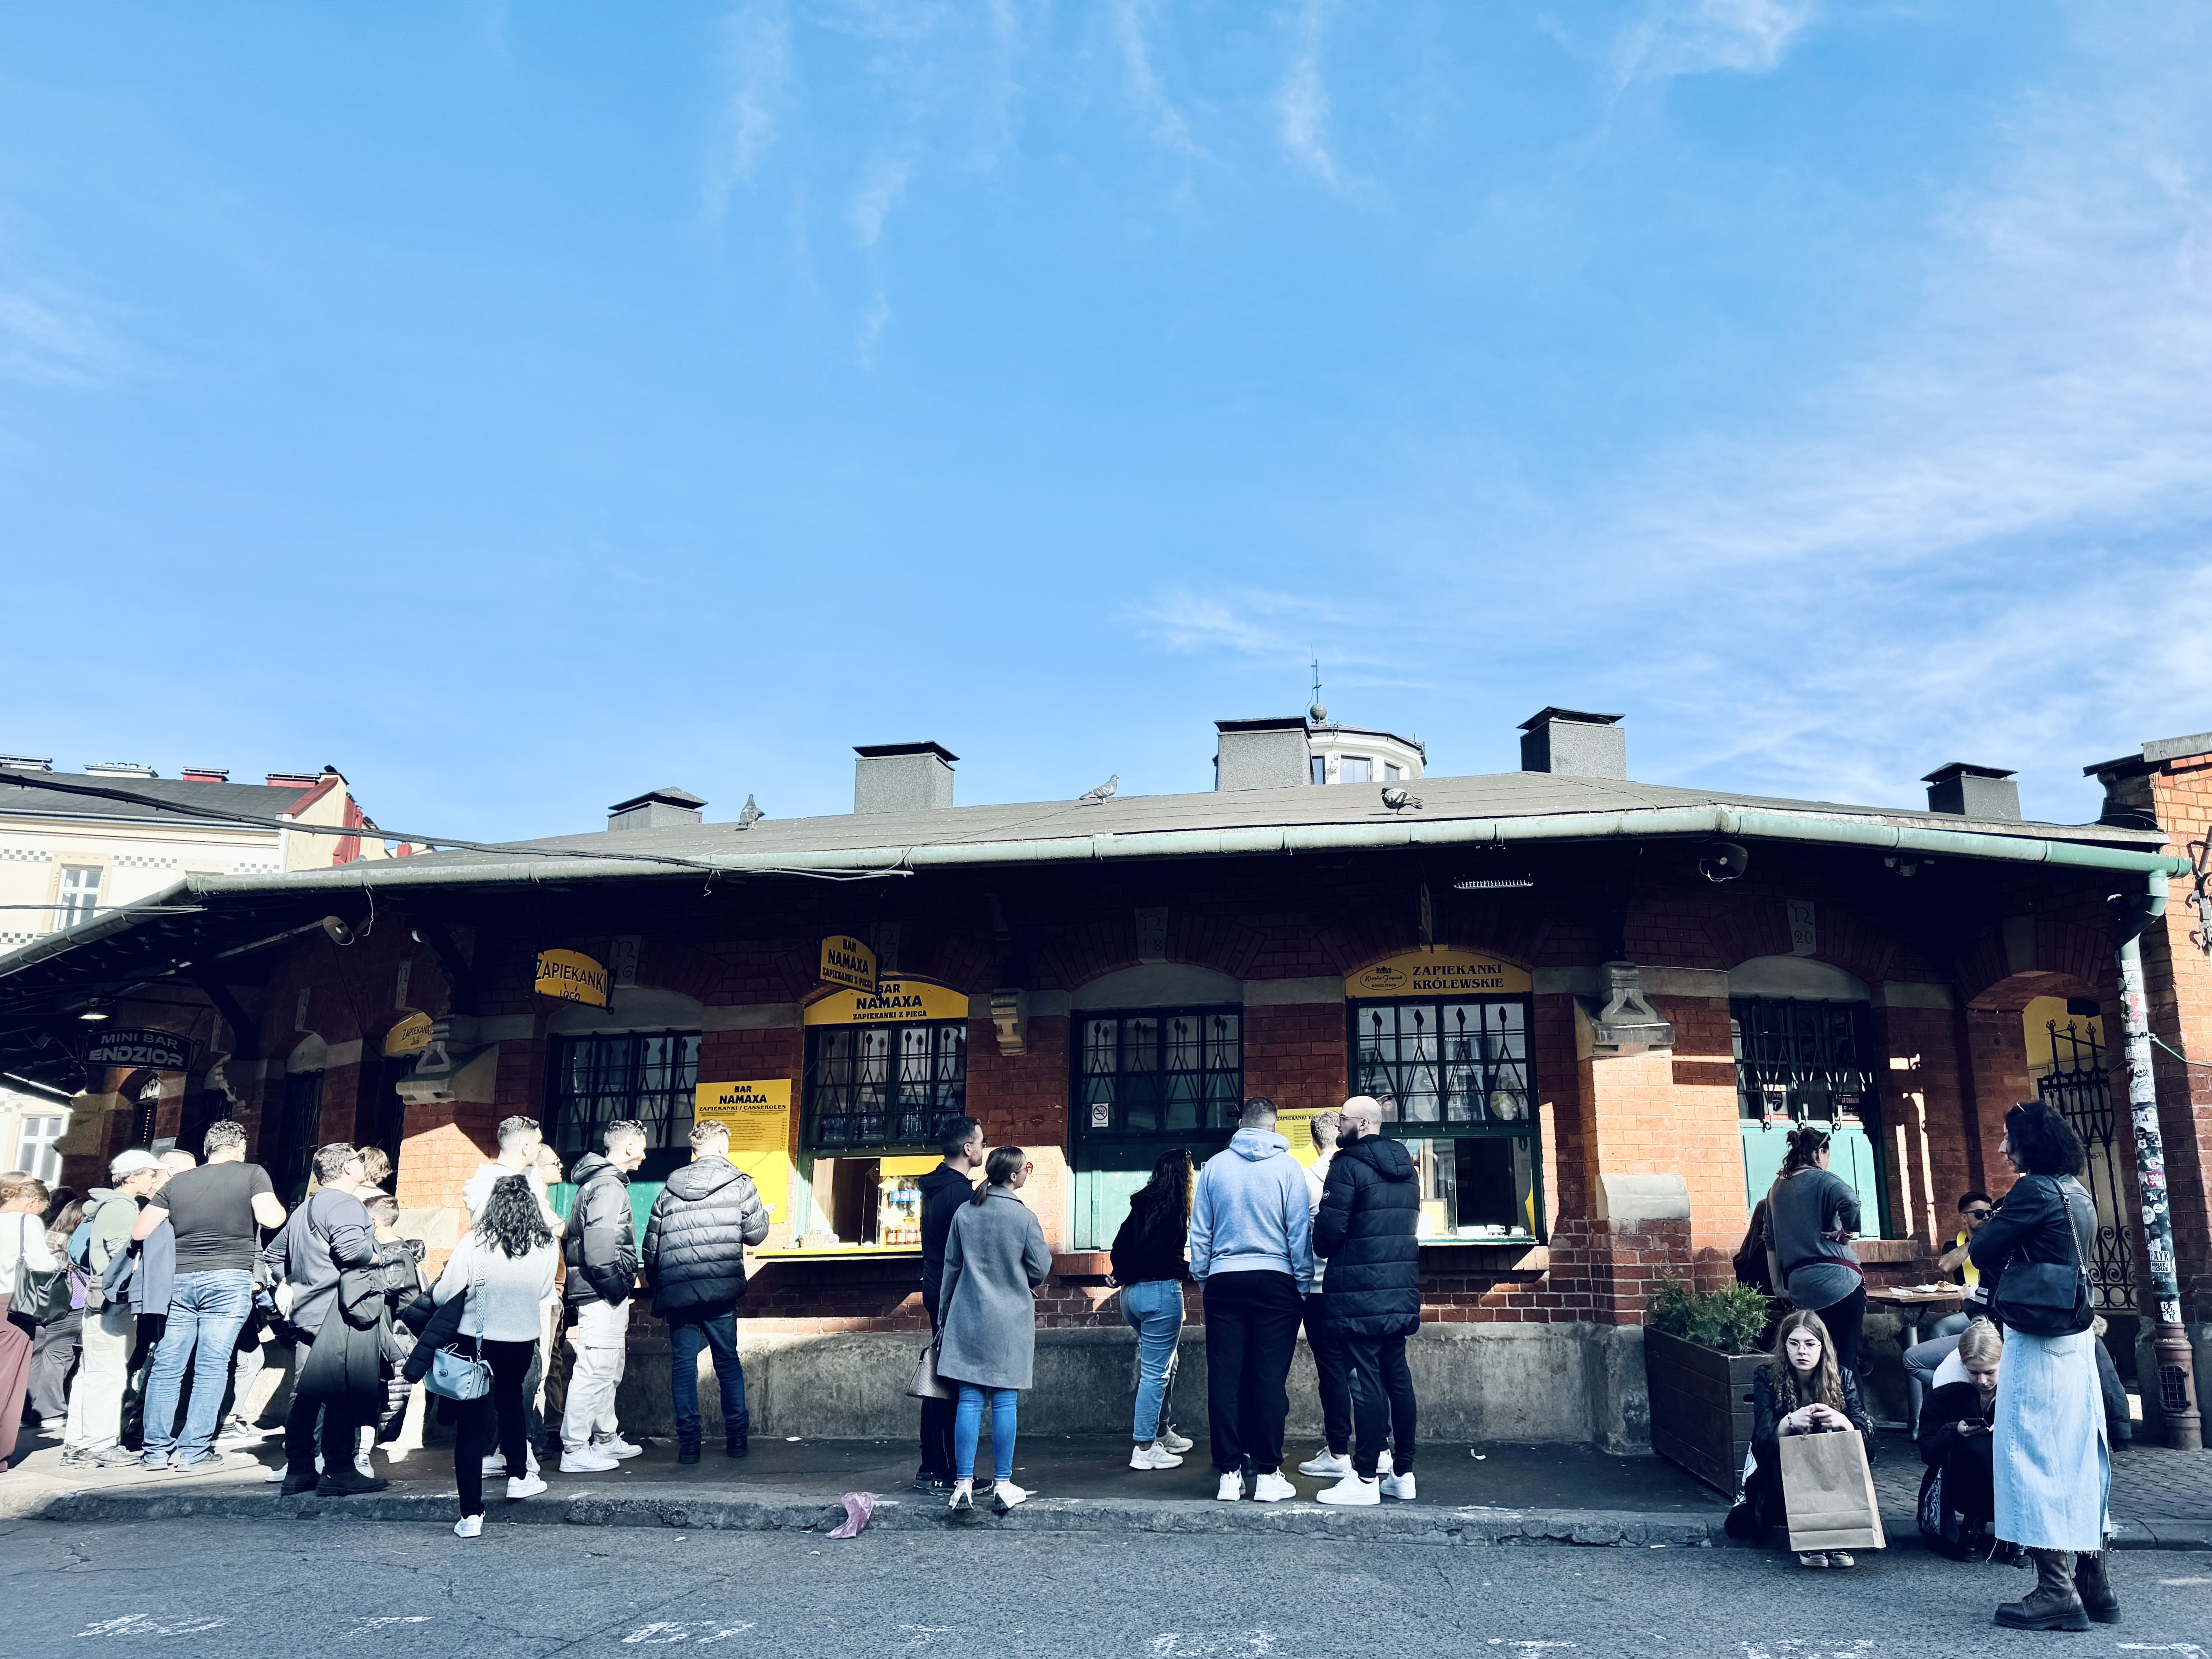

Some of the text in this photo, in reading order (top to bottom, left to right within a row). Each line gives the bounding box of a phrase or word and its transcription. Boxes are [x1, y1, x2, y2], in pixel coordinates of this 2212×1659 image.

[1795, 931, 1812, 944] 20
[843, 938, 857, 953] BAR
[1144, 938, 1162, 953] 18
[828, 949, 869, 975] NAMAXA
[536, 959, 607, 996] ZAPIEKANKI
[822, 967, 853, 983] ZAPIEKANKI
[855, 976, 858, 984] Z
[1413, 964, 1502, 976] ZAPIEKANKI
[1413, 977, 1503, 990] KRÓLEWSKIE
[560, 989, 581, 1001] LOCO
[856, 995, 922, 1010] NAMAXA
[853, 1012, 896, 1020] ZAPIEKANKI
[101, 1033, 178, 1050] MINI BAR
[88, 1045, 184, 1067] ENDZIOR
[719, 1094, 767, 1104] NAMAXA
